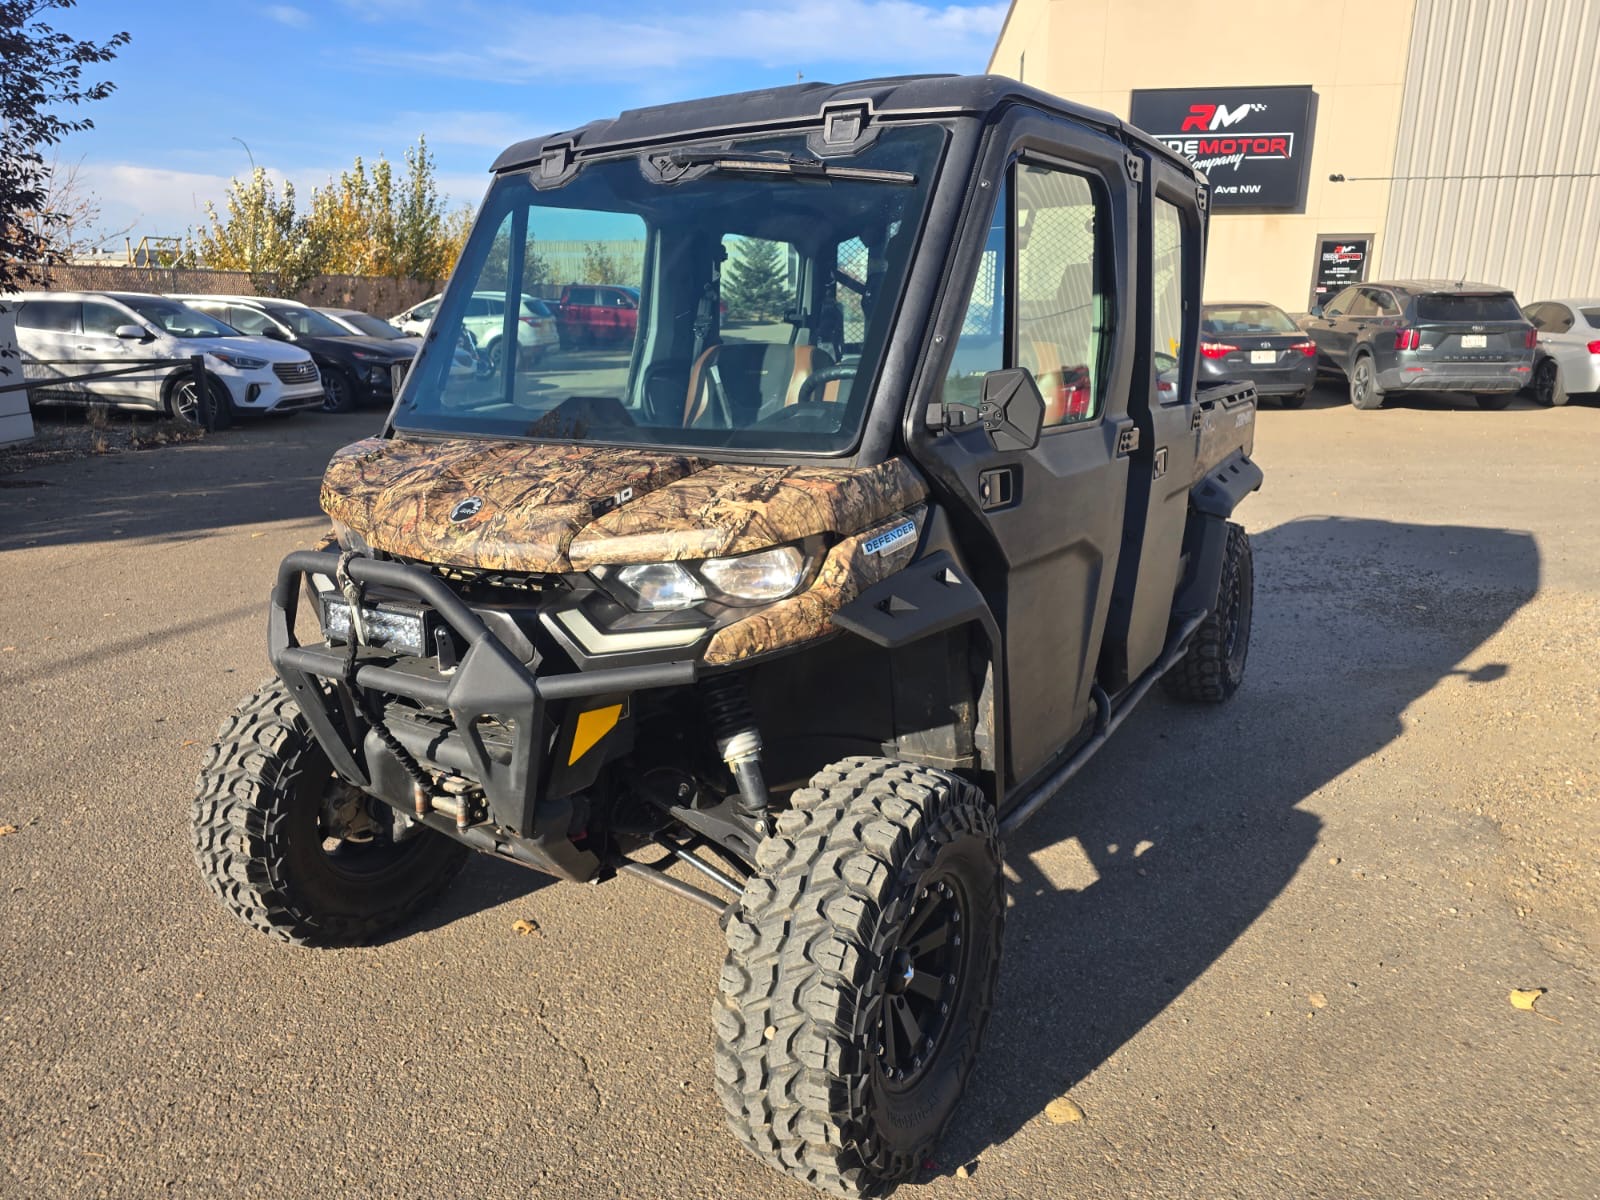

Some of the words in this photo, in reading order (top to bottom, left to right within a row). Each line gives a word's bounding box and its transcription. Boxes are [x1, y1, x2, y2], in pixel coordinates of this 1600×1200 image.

[1181, 104, 1251, 131] RM
[1214, 185, 1238, 194] Ave
[1240, 184, 1262, 193] NW
[865, 522, 915, 553] DEFENDER
